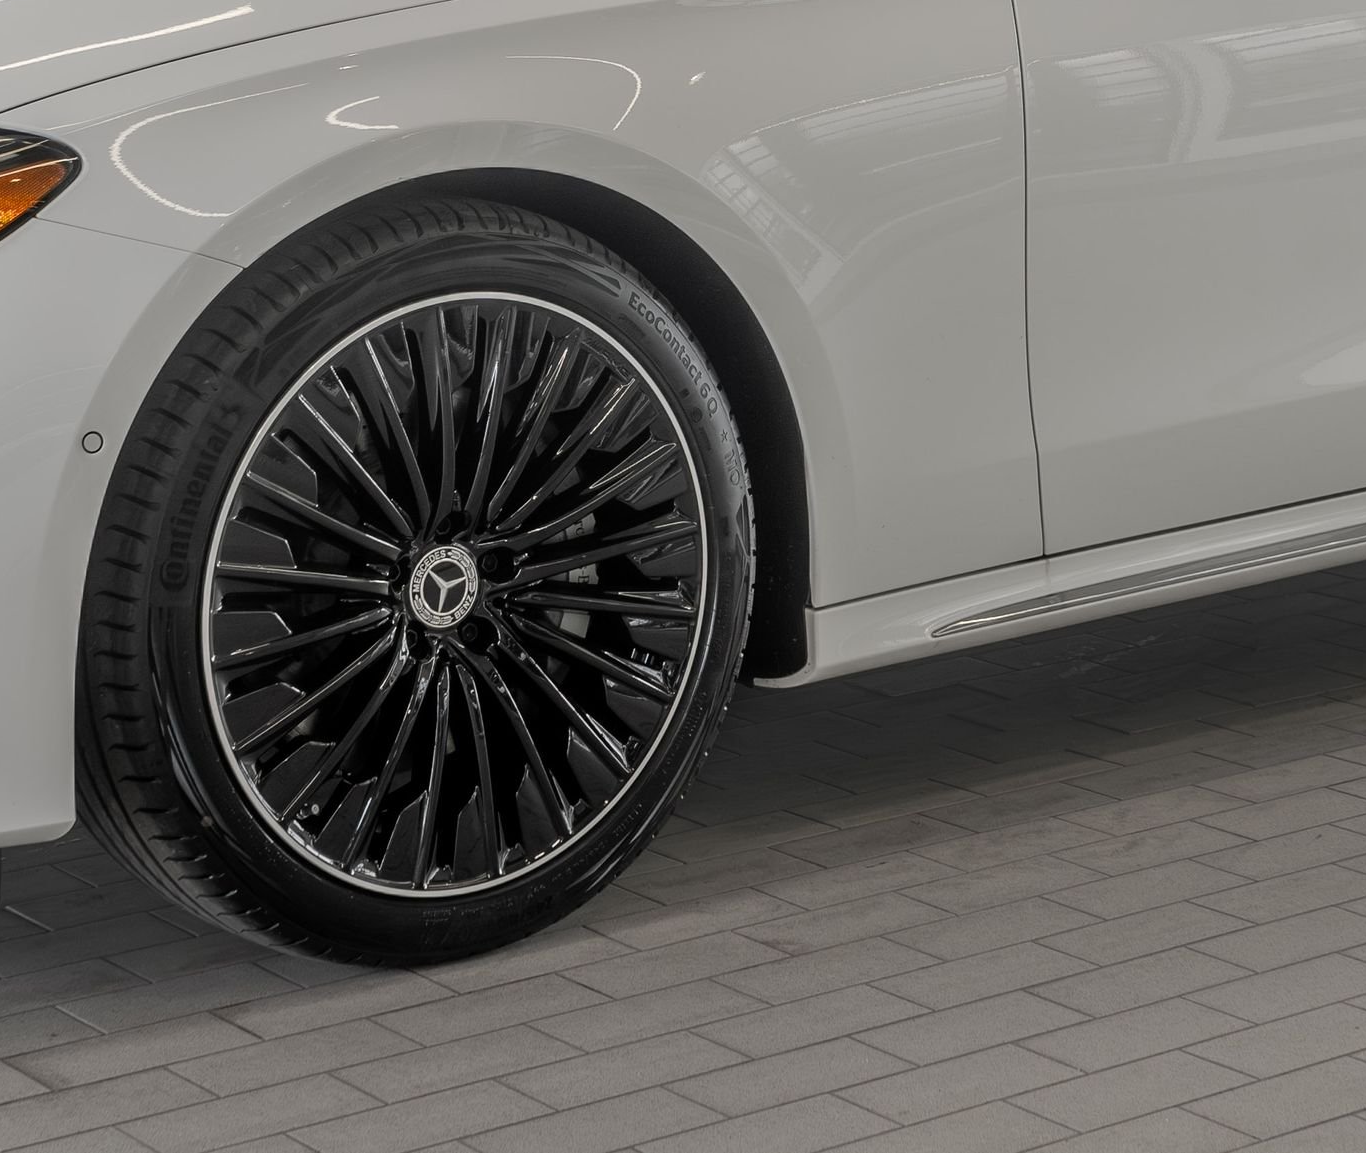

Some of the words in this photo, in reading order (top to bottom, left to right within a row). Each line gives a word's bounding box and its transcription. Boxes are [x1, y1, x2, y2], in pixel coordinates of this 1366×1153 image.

[628, 291, 703, 386] EcoContact
[412, 549, 447, 593] MERCEDES
[453, 594, 474, 620] BENZ
